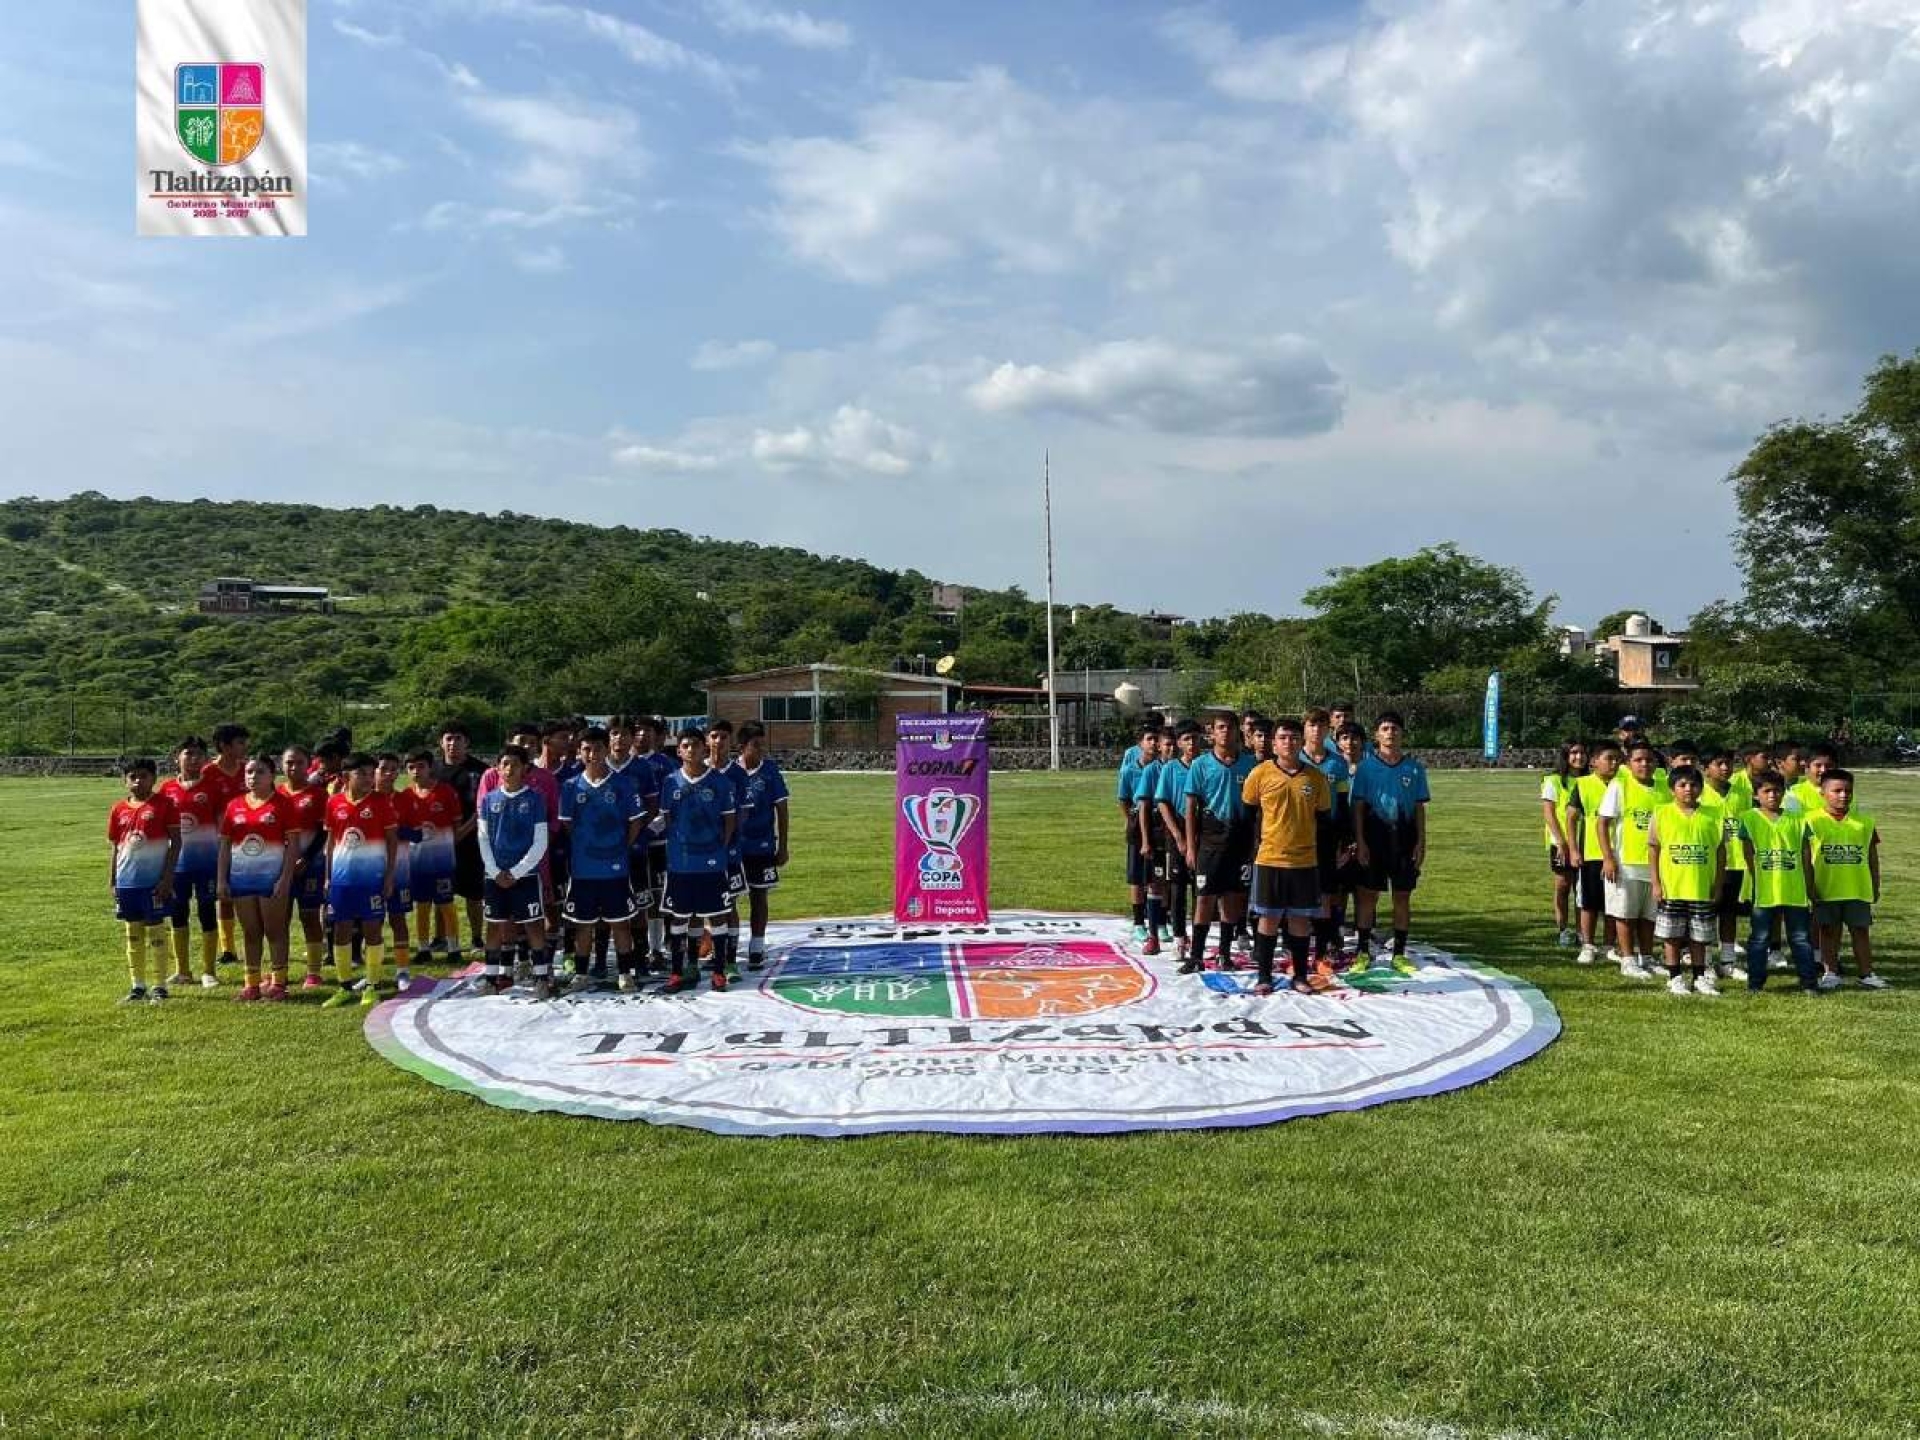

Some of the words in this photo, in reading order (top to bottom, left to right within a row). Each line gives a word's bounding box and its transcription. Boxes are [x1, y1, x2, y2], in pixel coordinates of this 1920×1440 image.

[922, 871, 961, 882] COPA
[935, 906, 977, 917] Deporte
[576, 1016, 1374, 1056] Tlaltizapán
